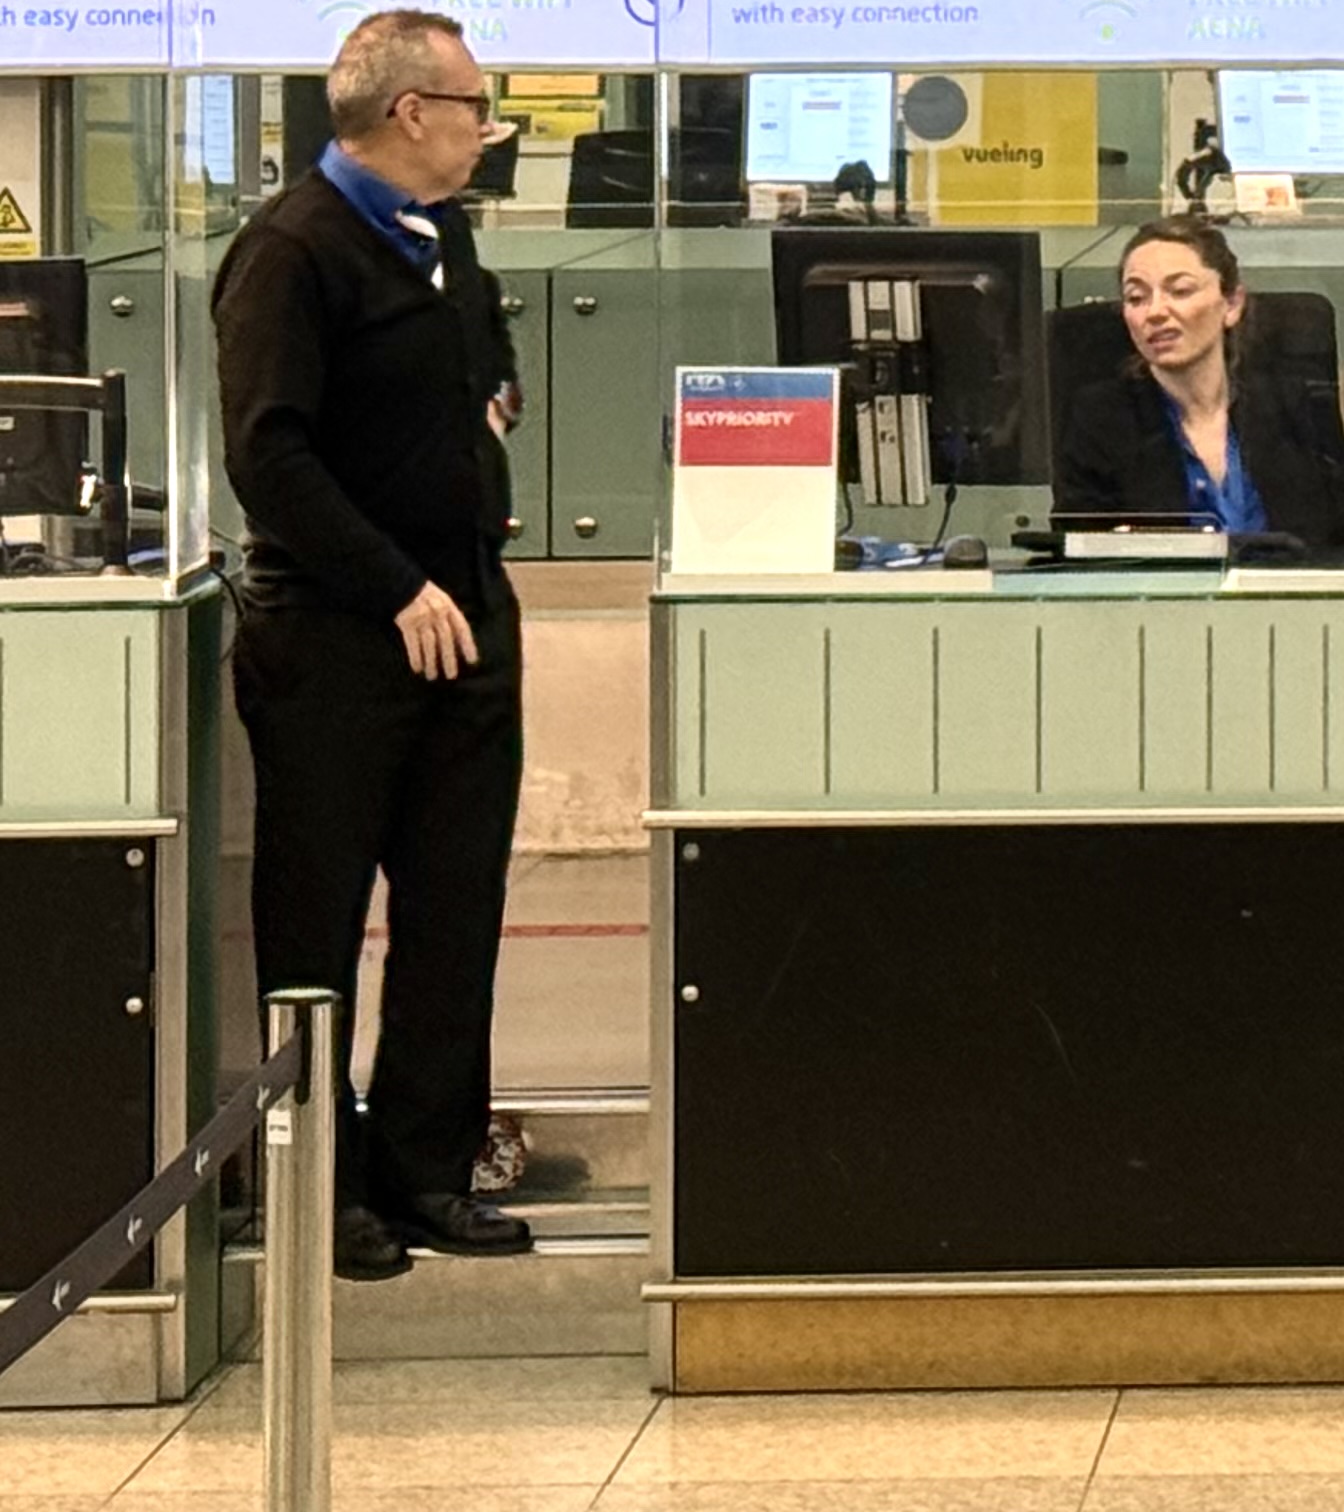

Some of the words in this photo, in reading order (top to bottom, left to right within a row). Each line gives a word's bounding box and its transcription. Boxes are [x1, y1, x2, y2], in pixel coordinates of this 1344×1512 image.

[24, 9, 79, 32] easy
[86, 8, 216, 26] conneon
[732, 2, 784, 24] with
[791, 5, 844, 29] easy
[851, 3, 979, 24] connection
[1187, 16, 1267, 39] AENA
[962, 140, 1044, 169] vueling
[685, 409, 795, 428] SKYPRIORITY
